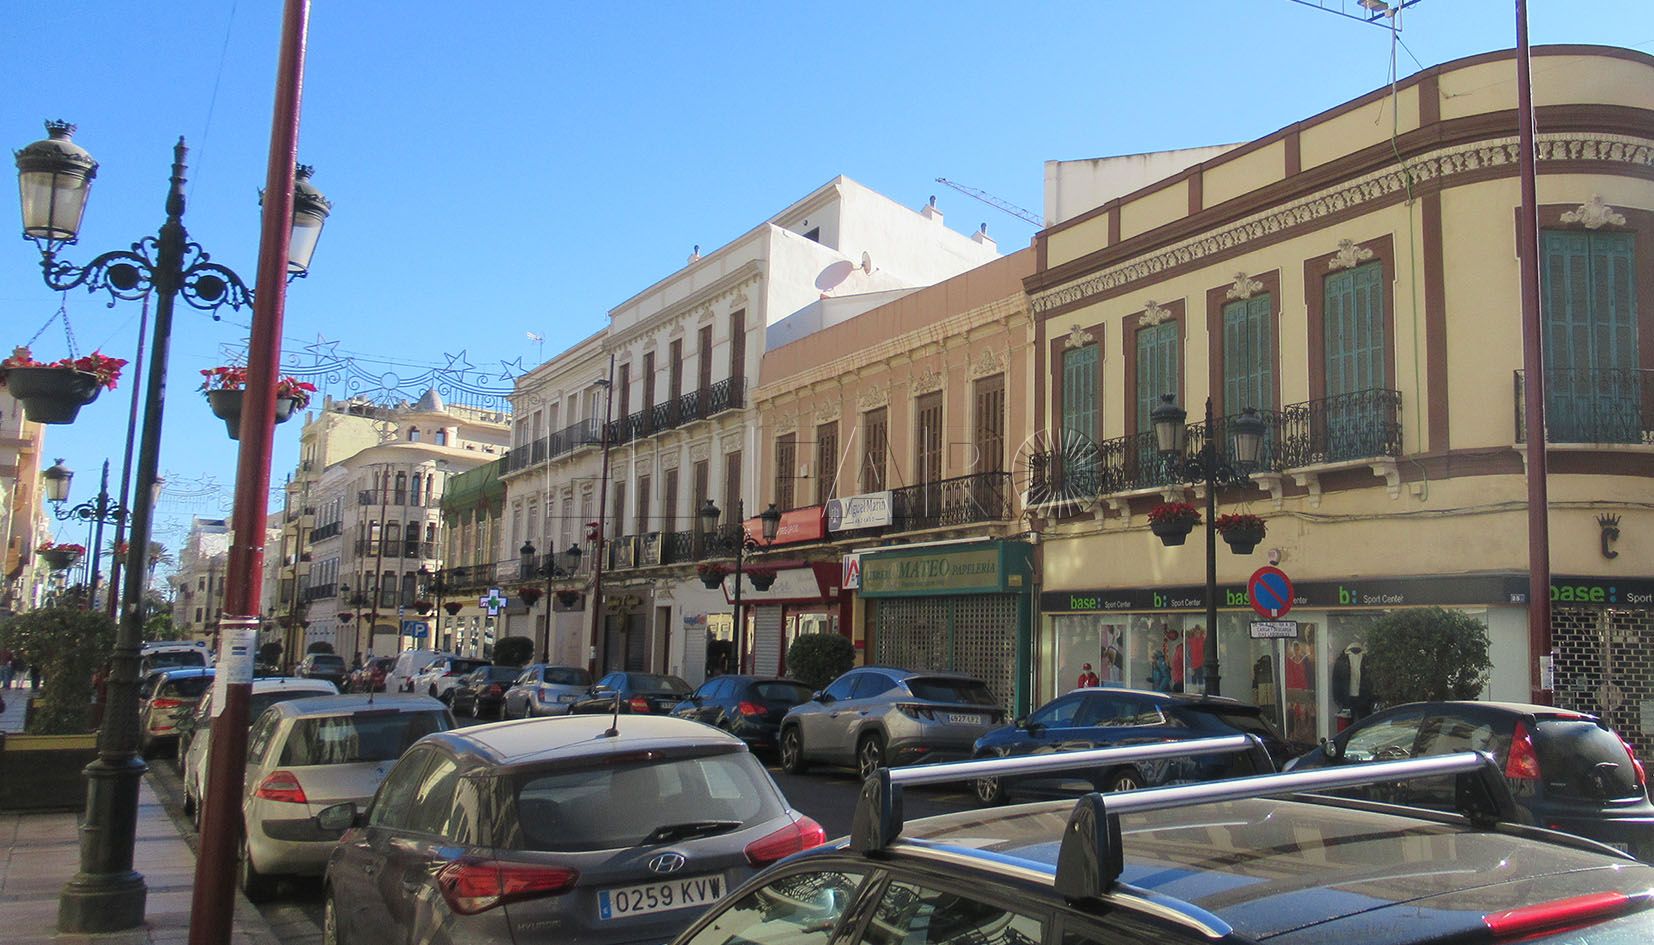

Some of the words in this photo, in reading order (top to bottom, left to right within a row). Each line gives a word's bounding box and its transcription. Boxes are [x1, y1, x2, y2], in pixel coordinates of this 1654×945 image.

[898, 558, 950, 579] MATEO
[951, 561, 996, 577] PAPELERÍA
[1171, 599, 1184, 608] Sport
[1184, 598, 1201, 607] Center
[1226, 588, 1250, 605] bas
[1363, 594, 1381, 605] Sport
[1382, 593, 1404, 604] Center
[1626, 592, 1653, 604] Sport
[1104, 600, 1119, 609] Sport
[1119, 600, 1131, 608] Center
[414, 623, 425, 638] P
[616, 884, 673, 913] 0259
[681, 876, 720, 904] KVW
